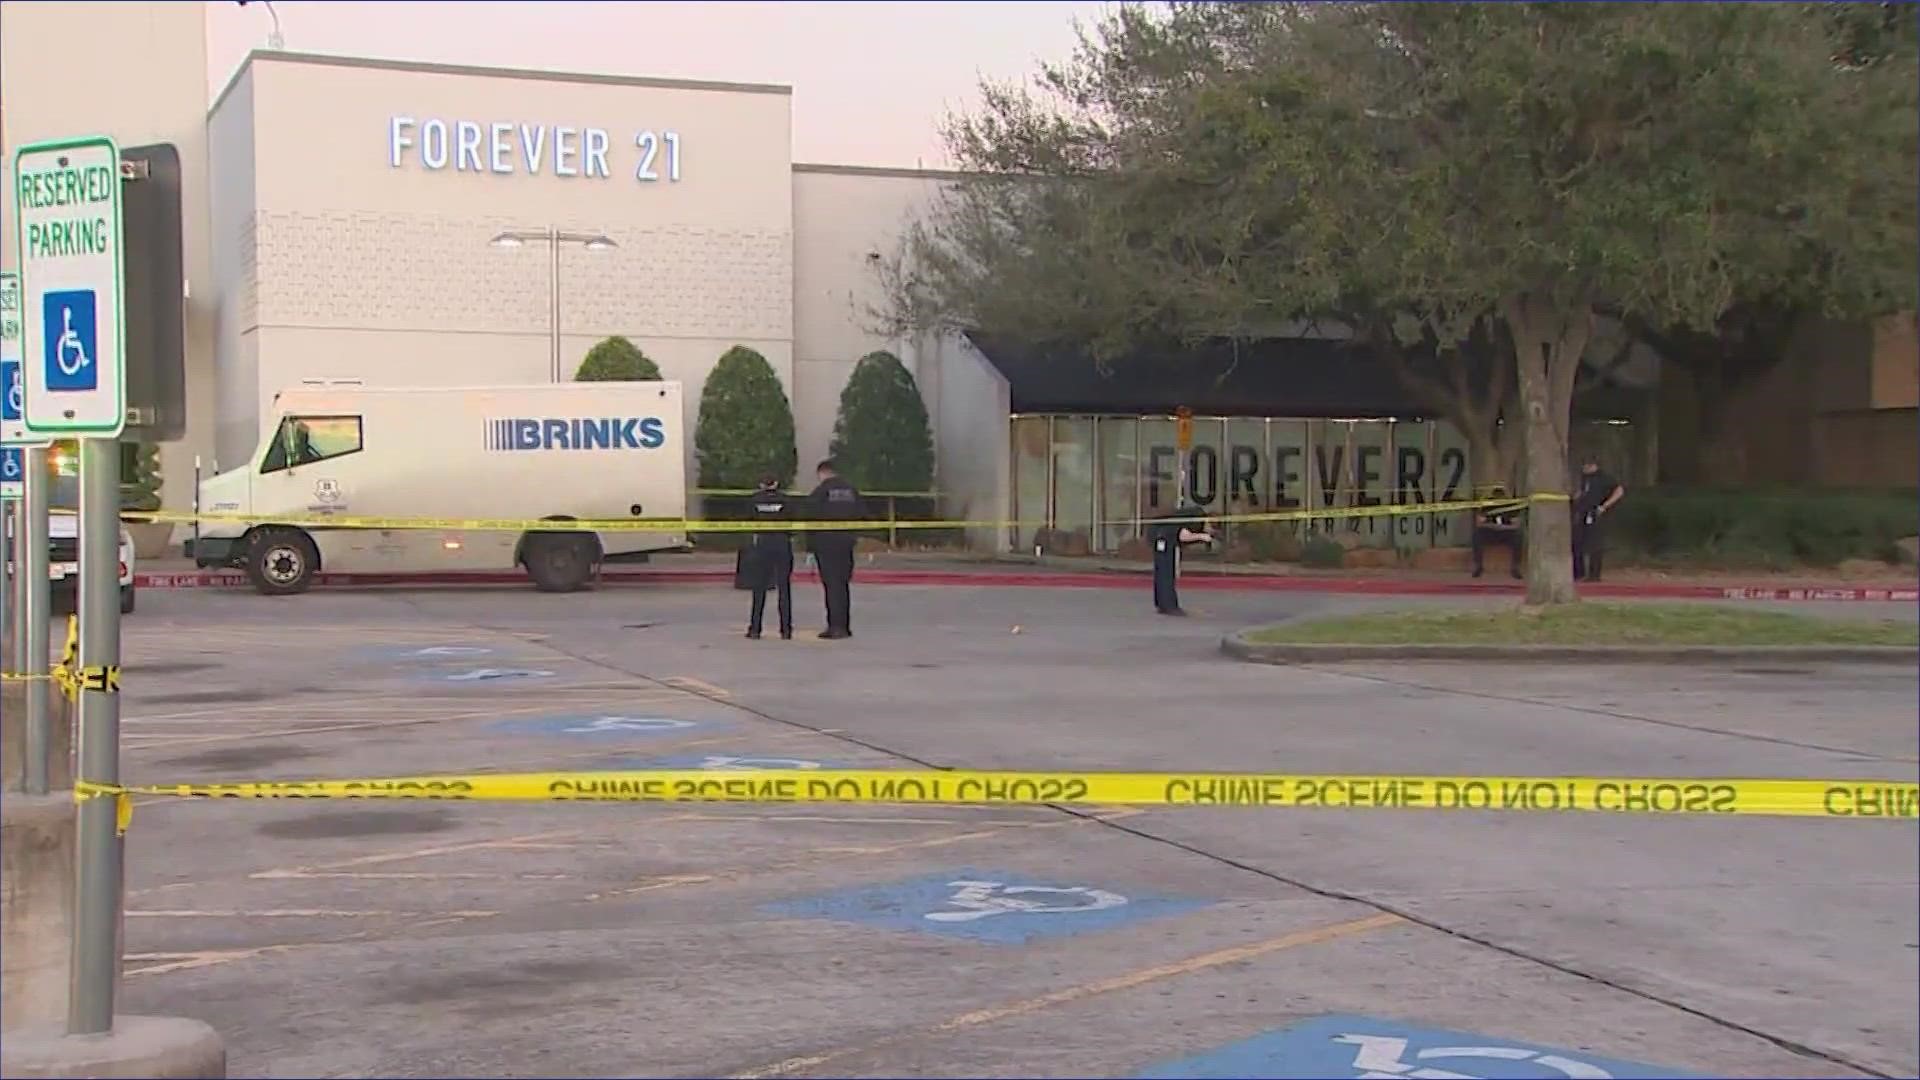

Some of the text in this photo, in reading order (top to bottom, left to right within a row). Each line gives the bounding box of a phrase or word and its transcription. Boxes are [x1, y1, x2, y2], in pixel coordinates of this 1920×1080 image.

[389, 116, 681, 182] FOREVER 21
[21, 167, 110, 208] RESERVED
[30, 218, 106, 257] PARKING
[515, 418, 665, 450] BRINKS
